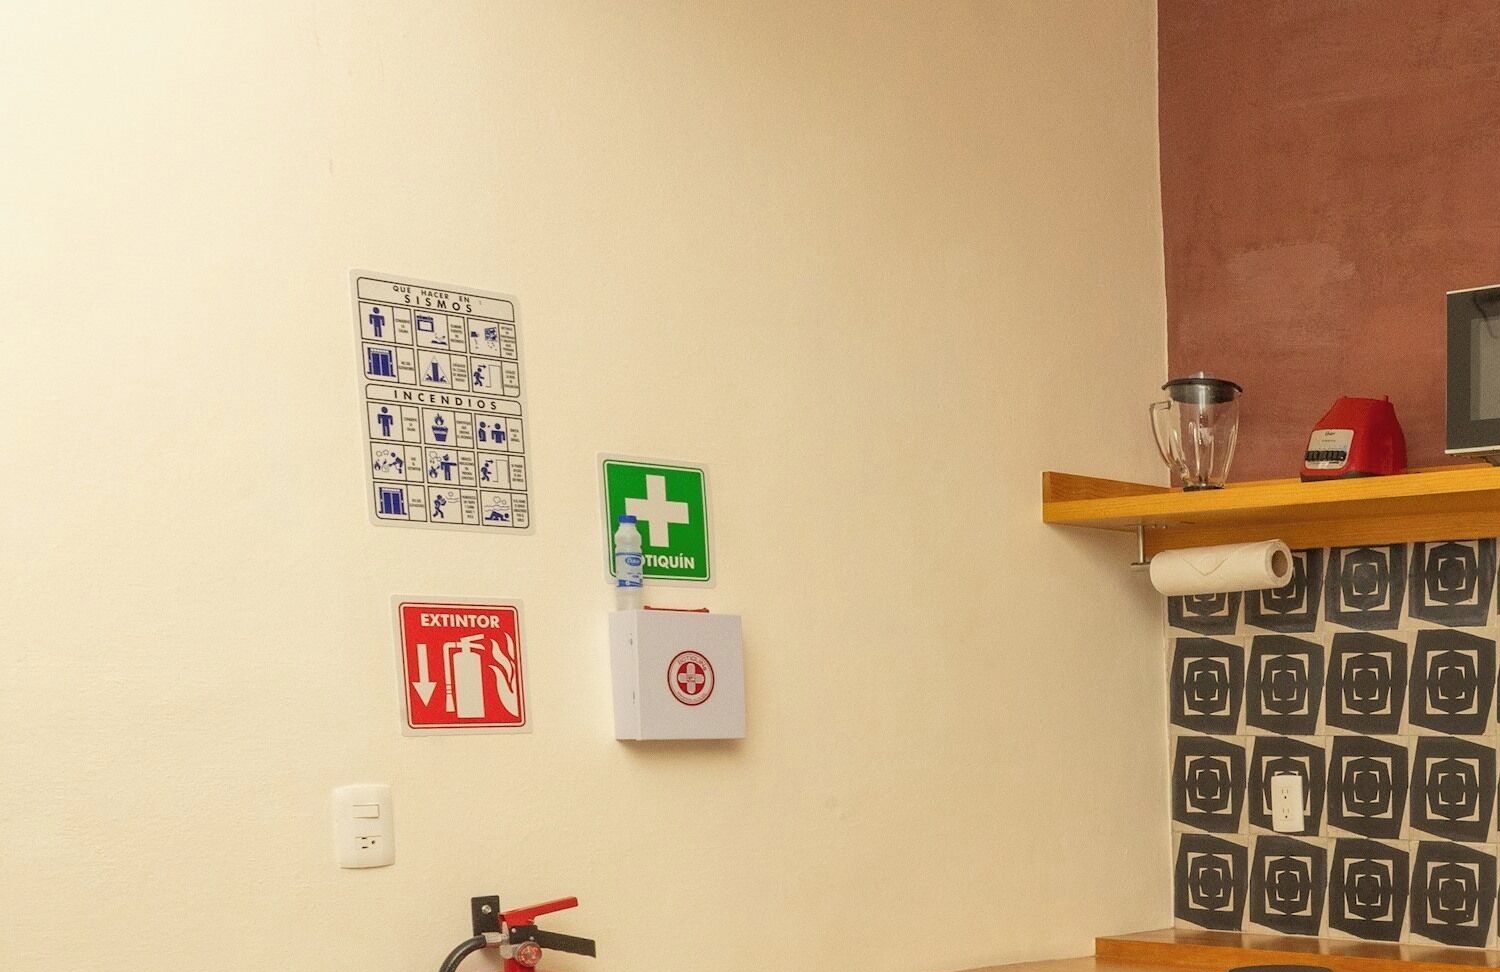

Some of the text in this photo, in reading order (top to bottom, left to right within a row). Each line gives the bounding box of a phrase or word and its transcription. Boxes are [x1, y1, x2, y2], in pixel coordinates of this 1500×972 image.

[421, 290, 449, 299] HACER
[404, 294, 472, 313] SISMOS
[394, 389, 497, 410] INCENDIOS
[641, 553, 695, 569] TIQUÍN
[420, 613, 500, 629] EXTINTOR
